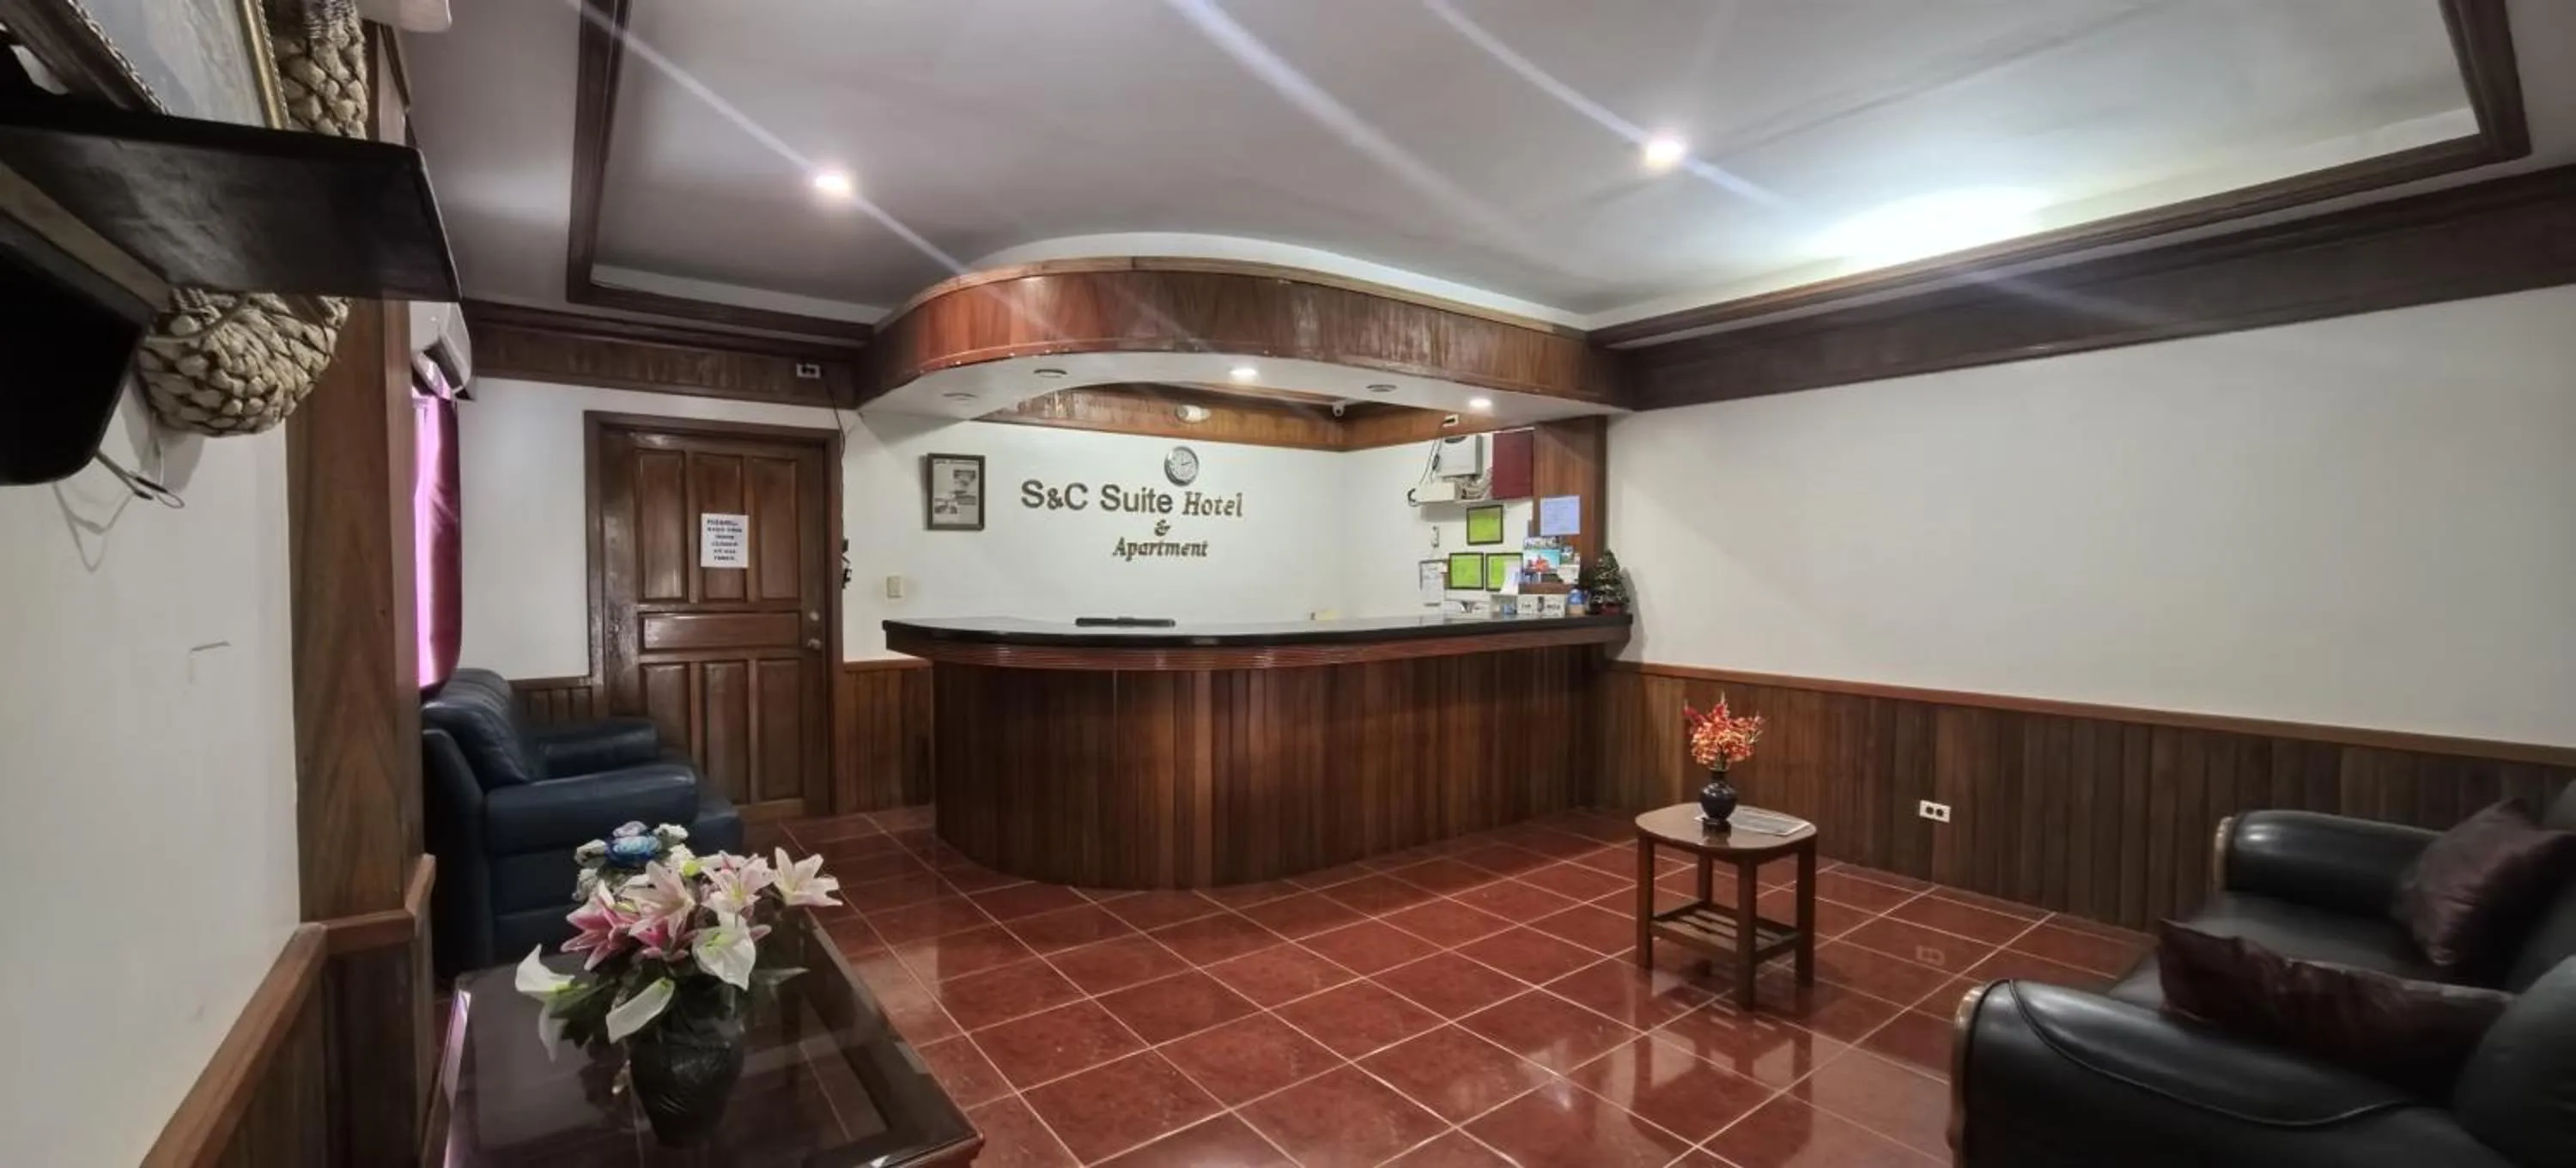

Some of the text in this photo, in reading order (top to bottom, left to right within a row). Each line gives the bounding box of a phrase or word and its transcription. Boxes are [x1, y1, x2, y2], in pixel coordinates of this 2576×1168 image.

[1021, 479, 1243, 518] S&C Suite Hotel
[1154, 519, 1171, 537] &
[1112, 536, 1210, 562] Apartment
